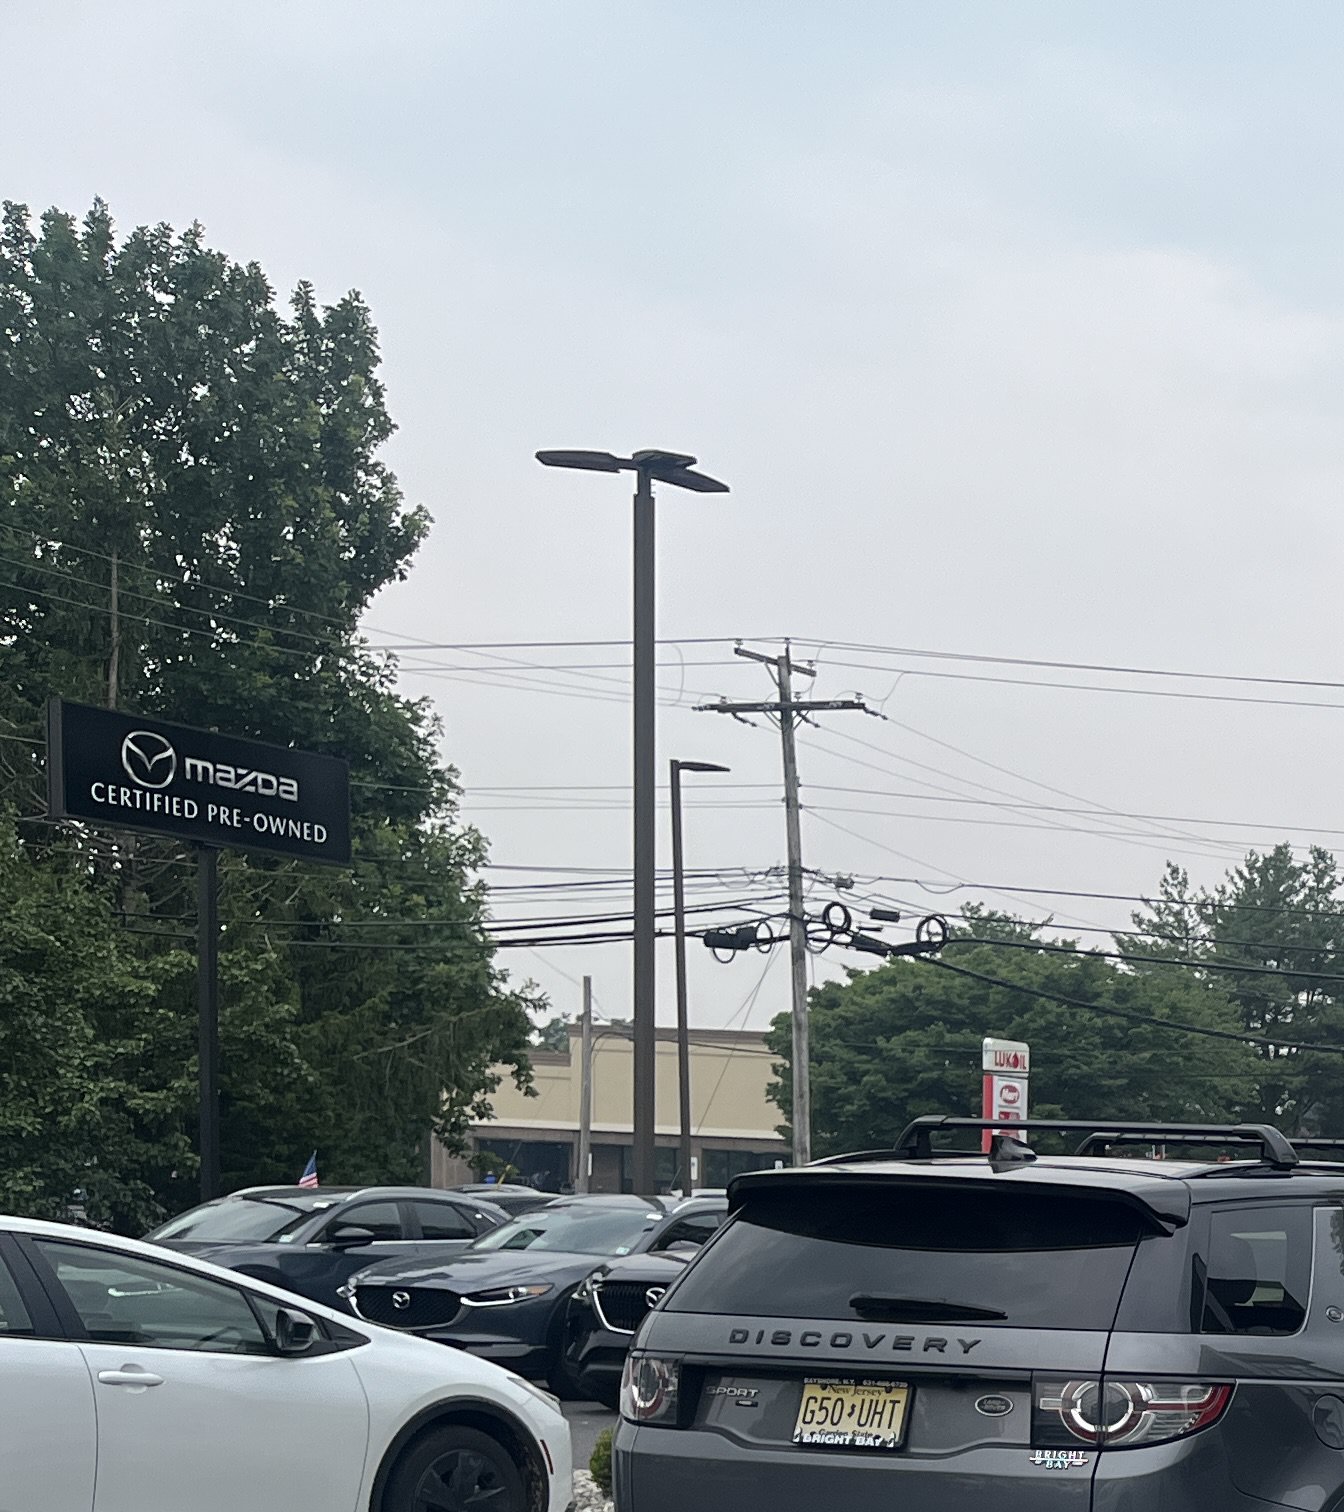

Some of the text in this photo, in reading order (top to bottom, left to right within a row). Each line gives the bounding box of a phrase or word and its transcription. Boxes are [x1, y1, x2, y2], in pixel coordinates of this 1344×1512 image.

[184, 757, 299, 801] mazda
[91, 782, 328, 843] CERTIFIED PRE-OWNED
[994, 1050, 1027, 1070] LUKOIL
[729, 1328, 982, 1354] DISCOVERY
[705, 1385, 759, 1398] SPORT
[828, 1385, 884, 1398] New Jersey
[802, 1396, 901, 1430] G50 UHT
[803, 1433, 884, 1447] BRIGHT BAY
[1035, 1449, 1085, 1460] BRIGHT
[1045, 1460, 1071, 1469] BAY
